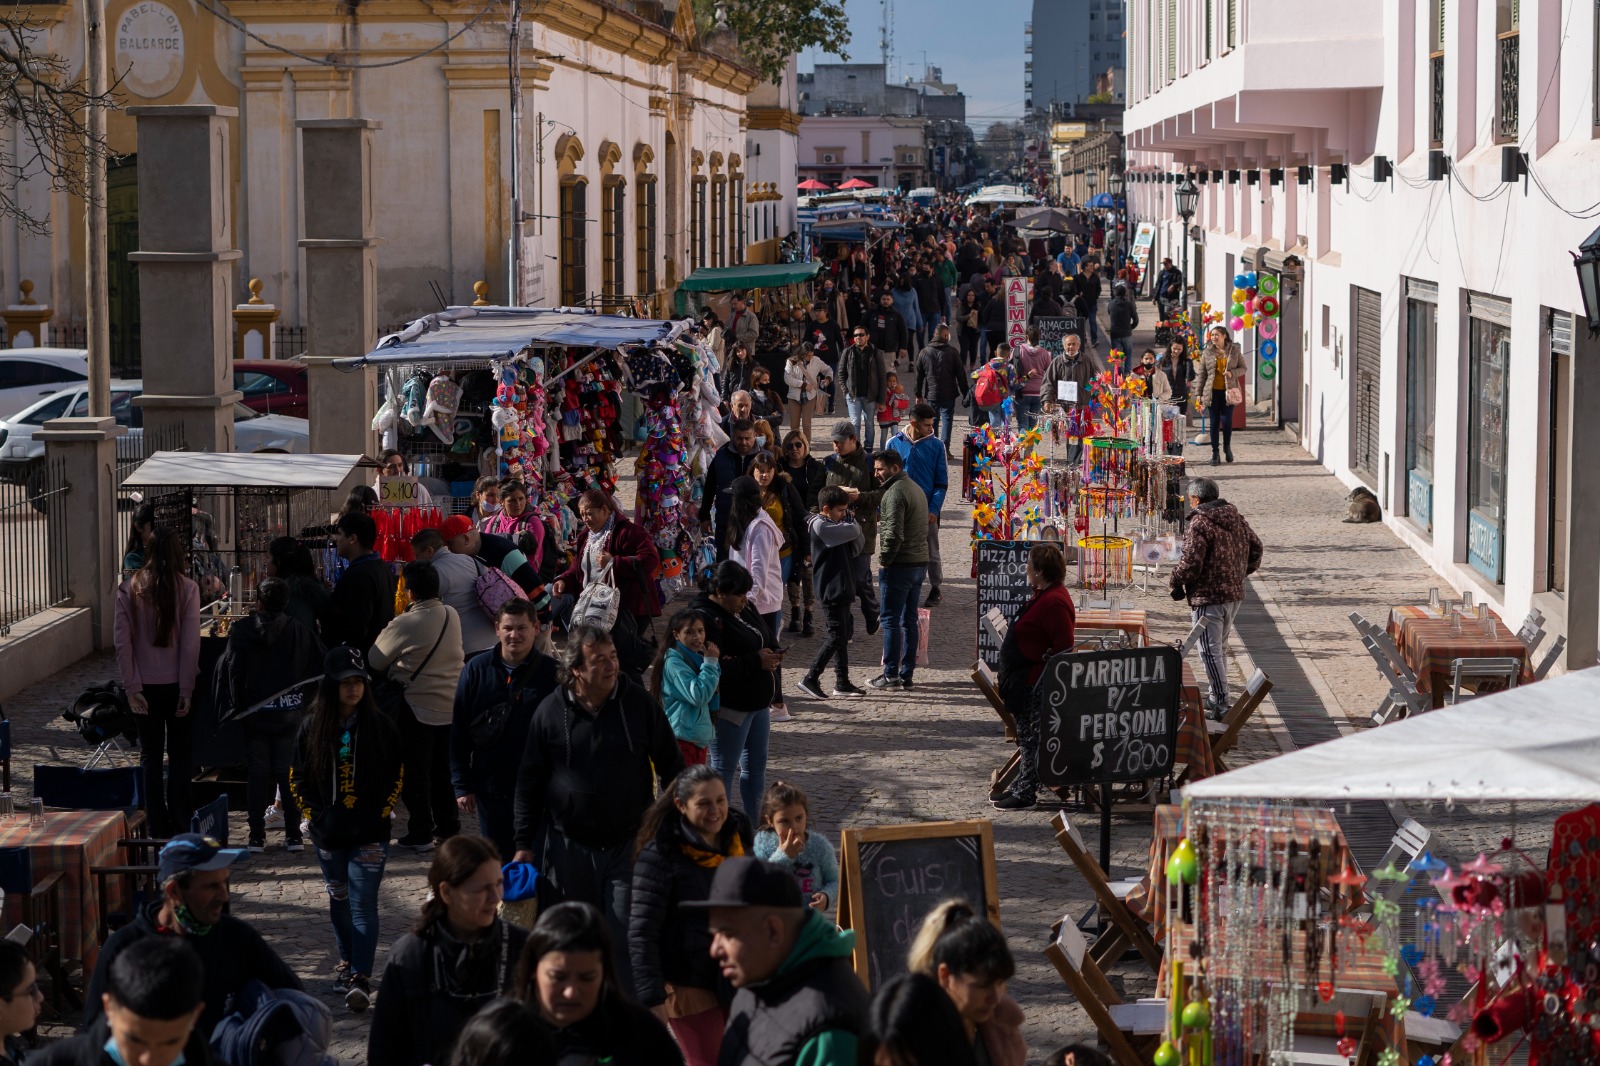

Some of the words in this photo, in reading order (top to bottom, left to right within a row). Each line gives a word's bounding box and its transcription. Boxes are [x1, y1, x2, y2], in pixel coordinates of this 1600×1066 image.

[121, 4, 179, 34] PABELLON
[119, 38, 180, 50] BALCARCE
[1039, 320, 1078, 331] ALMACEN
[380, 482, 391, 499] 3
[980, 549, 1017, 563] PIZZA
[1071, 655, 1166, 688] PARRILLA
[1080, 708, 1167, 741] PERSONA
[1112, 736, 1169, 775] 1800
